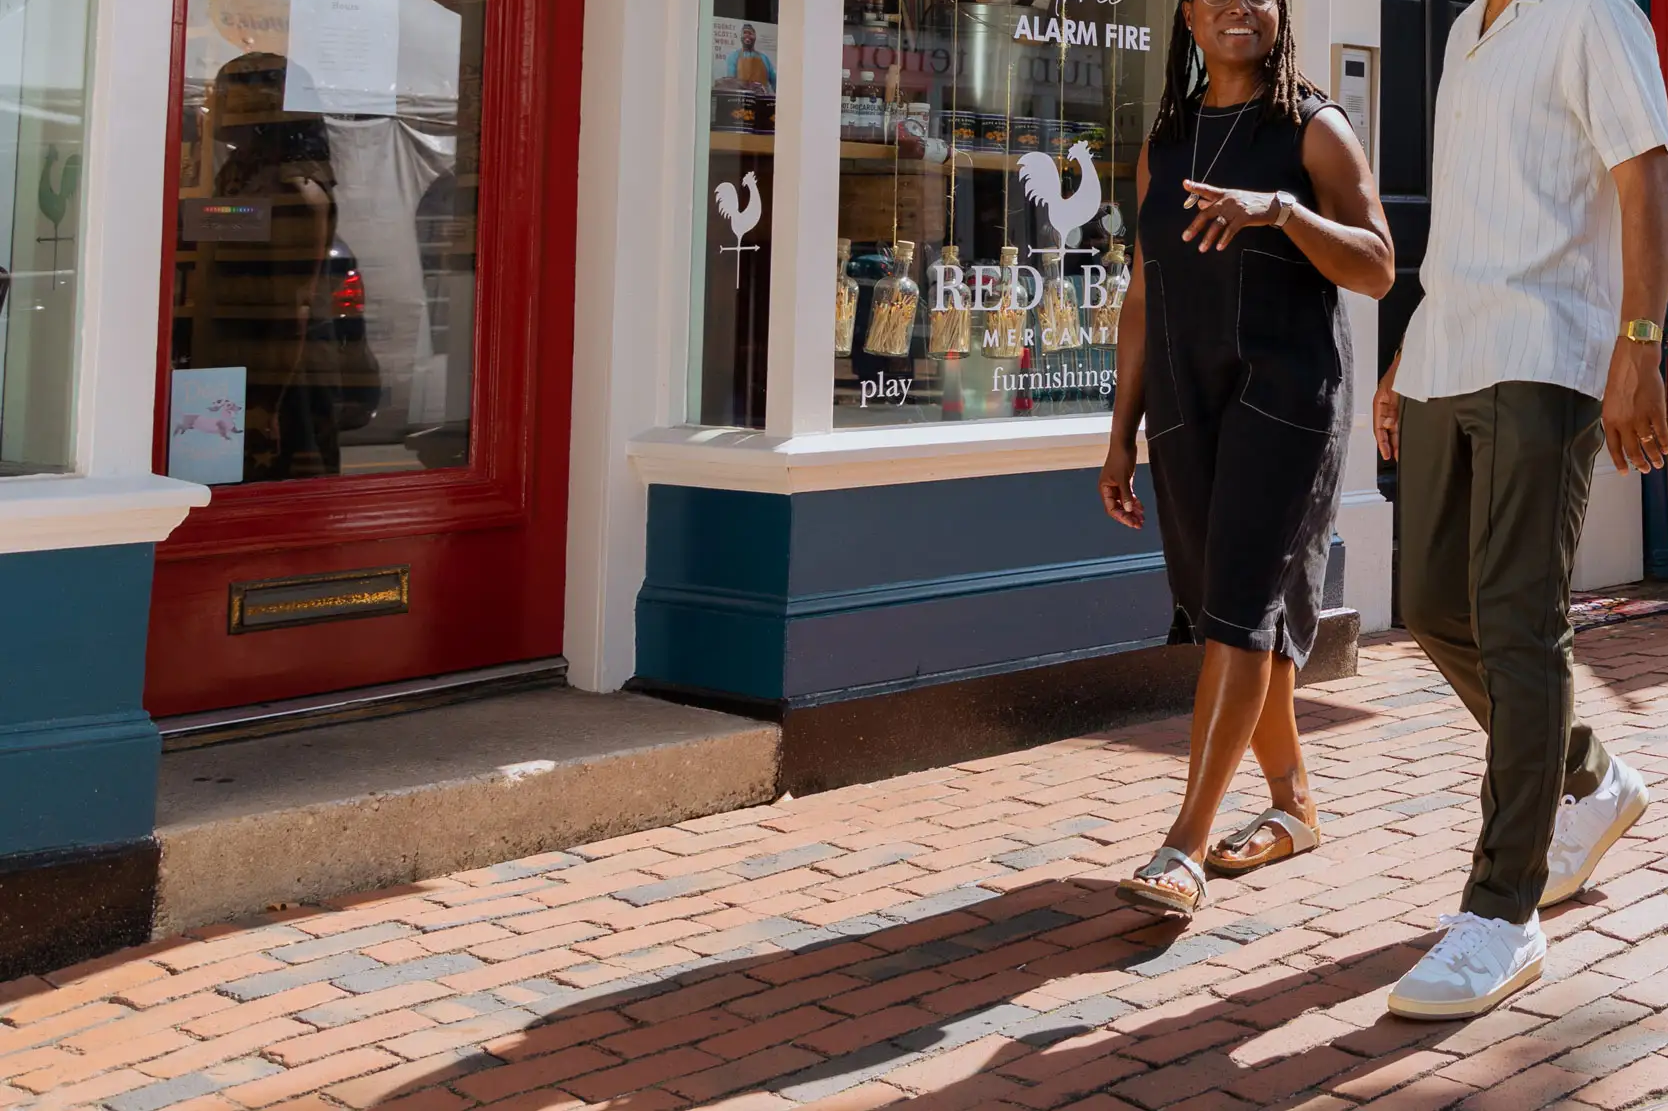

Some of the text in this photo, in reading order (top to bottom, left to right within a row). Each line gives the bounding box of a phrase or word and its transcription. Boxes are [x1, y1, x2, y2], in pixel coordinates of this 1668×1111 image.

[1014, 14, 1151, 52] ALARM FIRE
[930, 263, 1131, 312] RED BA
[982, 325, 1119, 348] MERCANTI
[859, 363, 1119, 408] play furnishings
